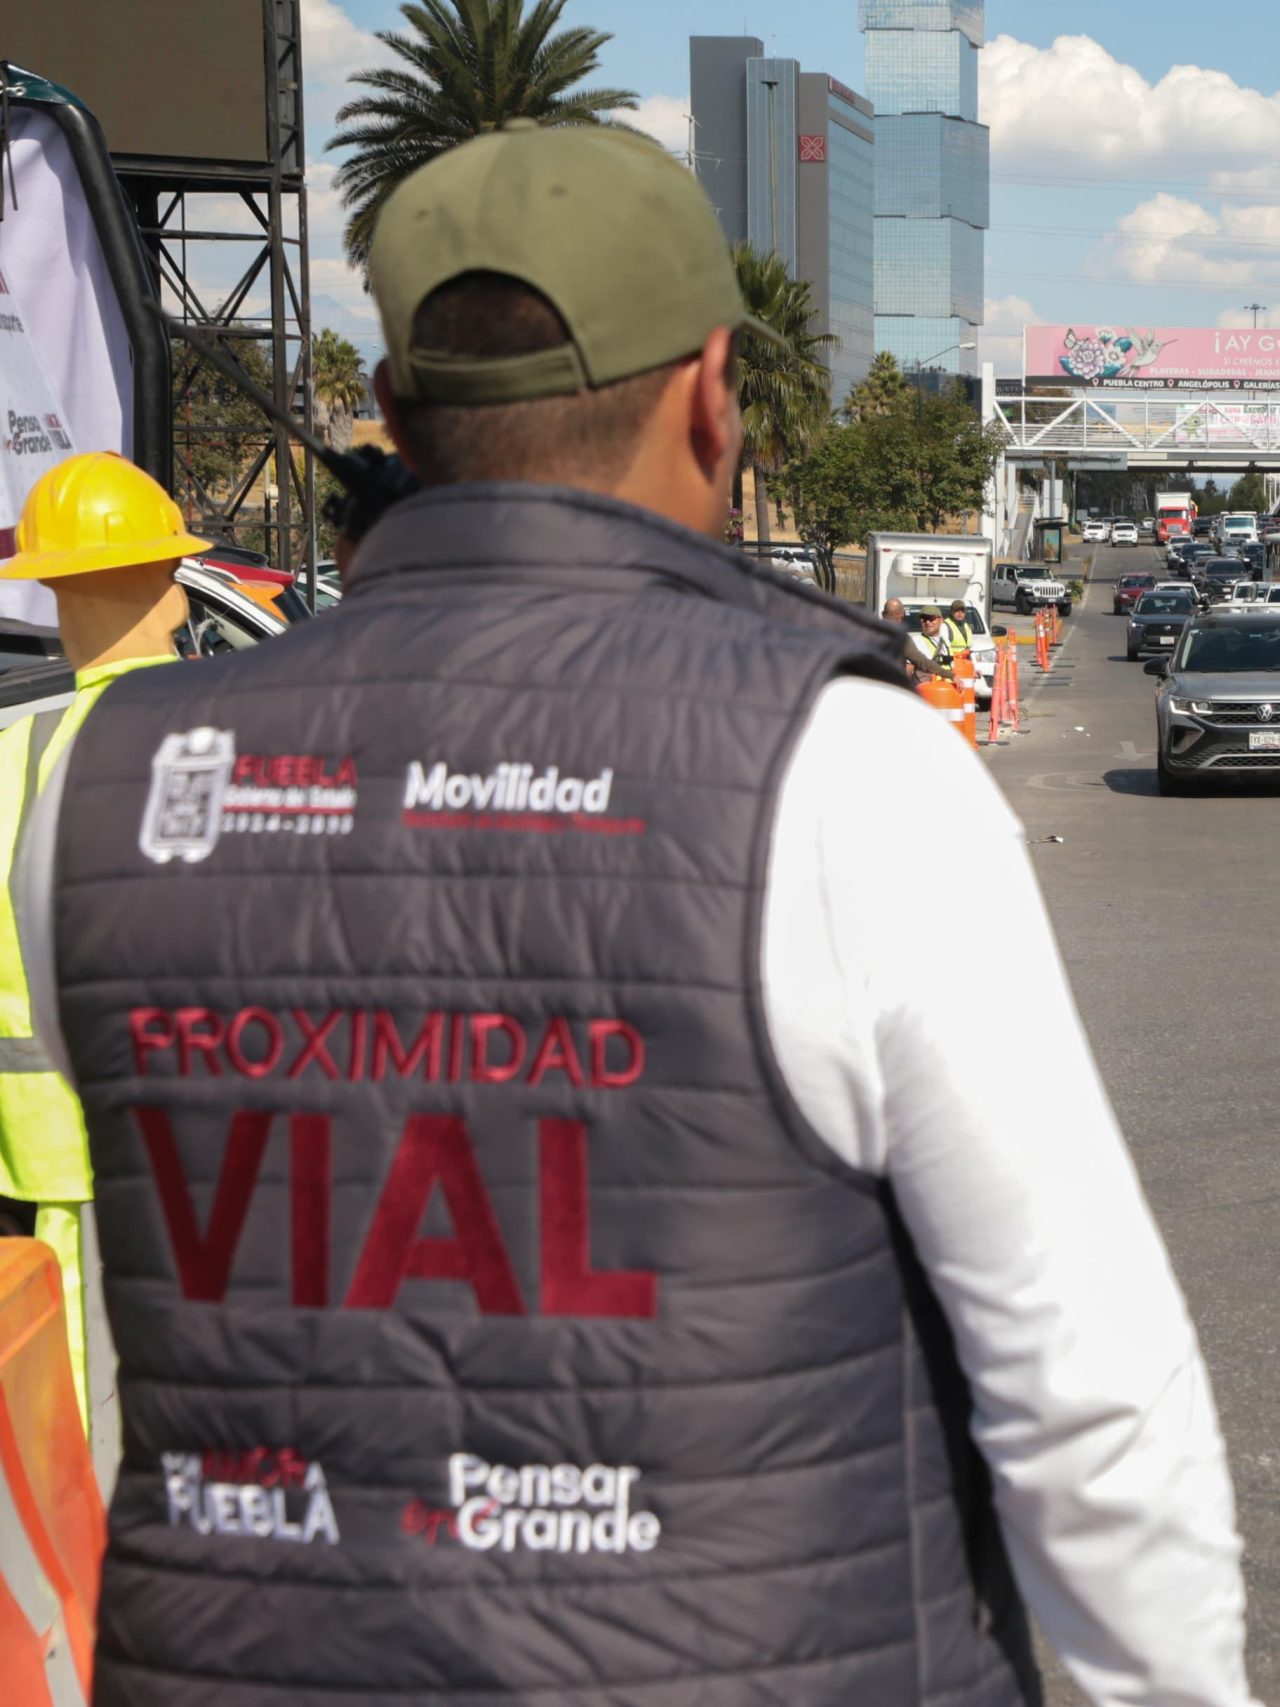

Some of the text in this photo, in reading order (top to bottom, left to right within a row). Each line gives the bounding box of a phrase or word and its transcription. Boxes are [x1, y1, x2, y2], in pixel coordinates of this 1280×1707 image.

[1103, 379, 1165, 388] PUEBLA CENTRO
[1149, 367, 1189, 376] PLAYERAS
[1254, 368, 1280, 377] JEANS
[1178, 380, 1230, 389] ANGELÓPOLIS
[1243, 381, 1280, 390] GALERÍAS
[403, 760, 613, 813] Movilidad
[129, 1006, 645, 1089] PROXIMIDAD
[133, 1105, 657, 1319] VIAL
[449, 1452, 641, 1507] Pensar
[166, 1474, 341, 1545] PUEBLA
[457, 1495, 661, 1554] Grande
